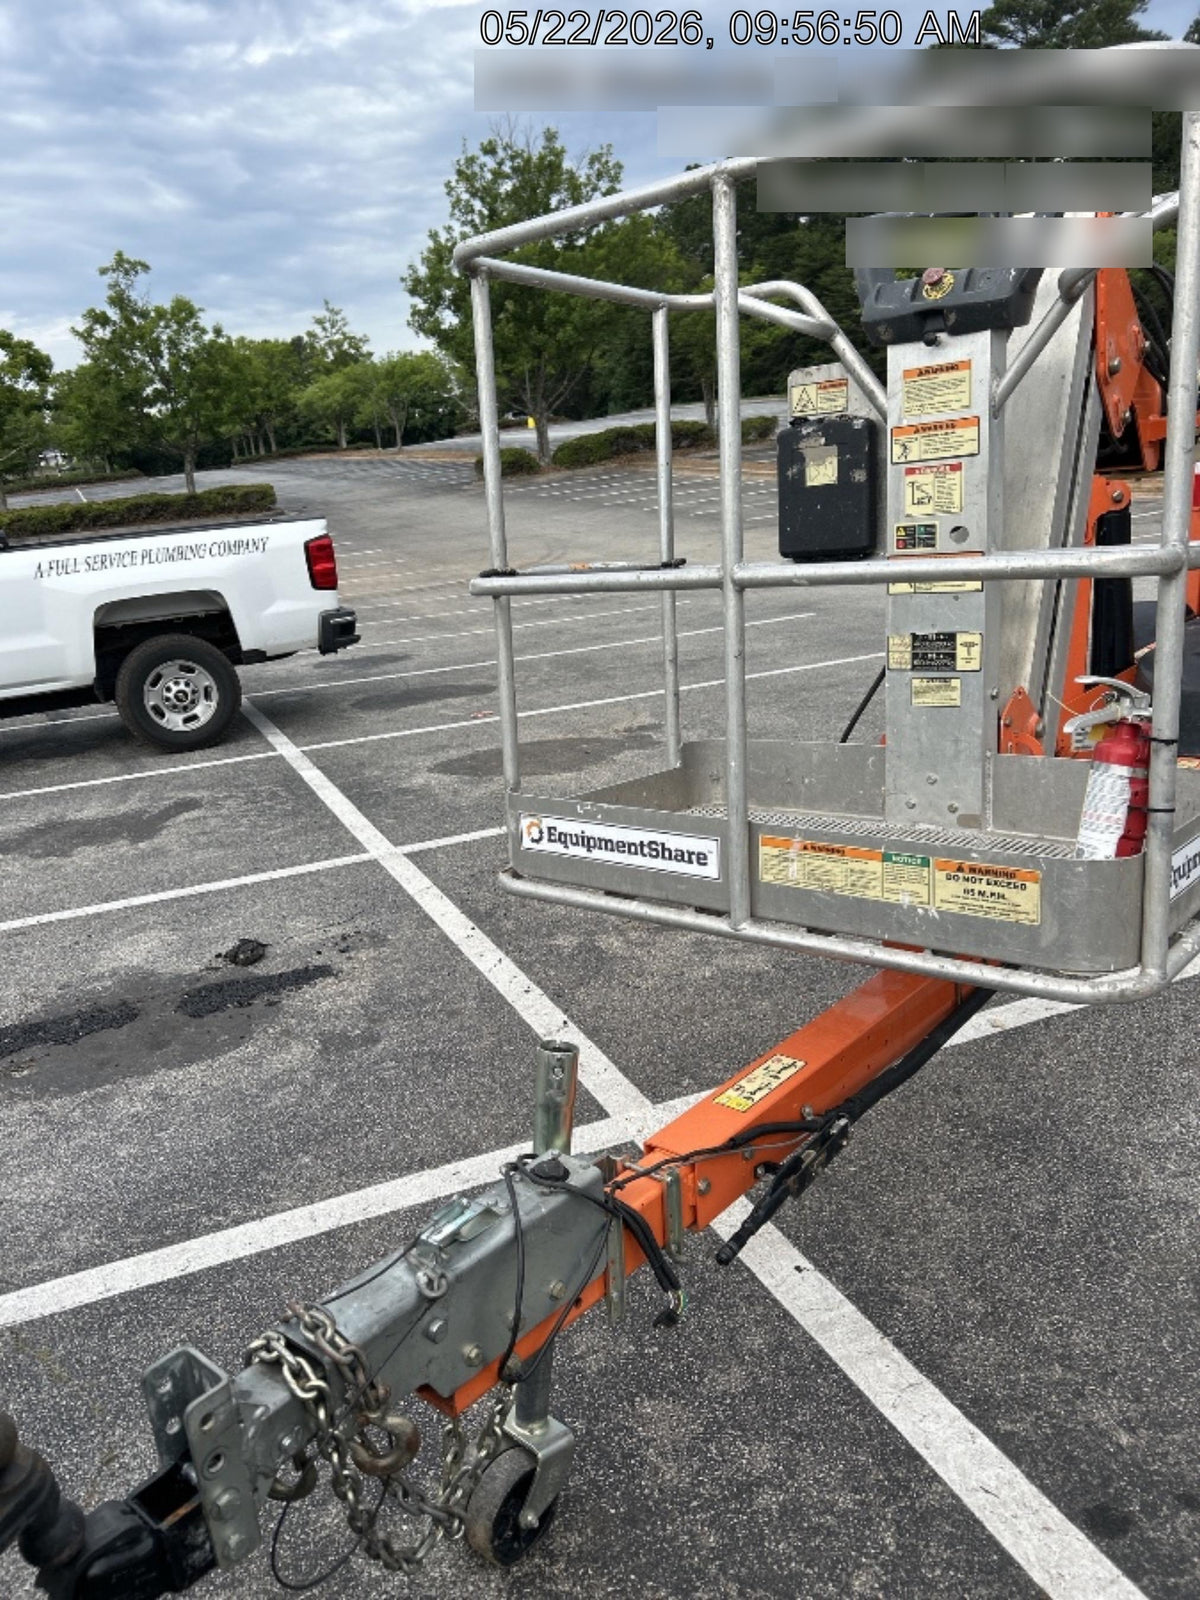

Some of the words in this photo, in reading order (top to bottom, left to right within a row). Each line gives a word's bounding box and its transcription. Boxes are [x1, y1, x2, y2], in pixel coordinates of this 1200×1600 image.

[33, 562, 44, 579] A
[47, 557, 81, 577] FULL
[84, 551, 137, 572] SERVICE
[140, 543, 207, 566] PLUMBING
[208, 537, 269, 558] COMPANY
[547, 826, 709, 867] EquipmentShare
[891, 854, 922, 866] NOTICE
[945, 873, 960, 882] DO
[962, 875, 983, 885] NOT
[986, 878, 1027, 891] EXCEED
[969, 867, 1016, 879] WARNING
